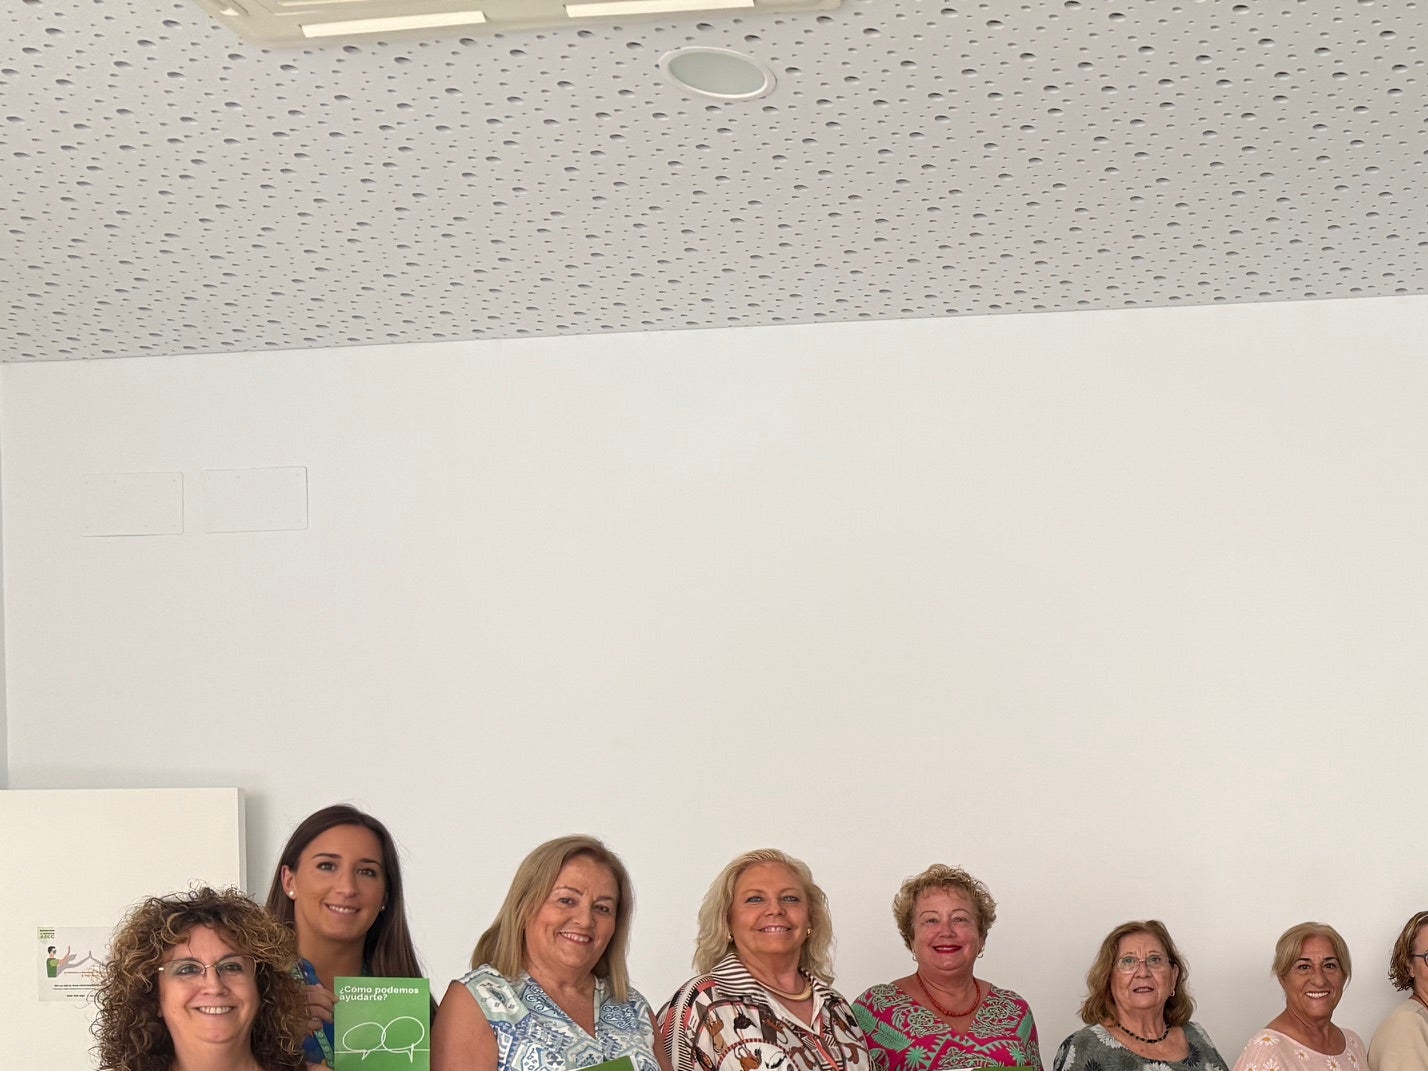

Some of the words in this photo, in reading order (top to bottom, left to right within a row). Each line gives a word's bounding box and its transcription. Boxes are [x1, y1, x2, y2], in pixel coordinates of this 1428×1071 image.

[339, 986, 372, 994] ¿Cómo
[375, 986, 419, 994] podemos
[339, 993, 388, 1002] ayudarte?
